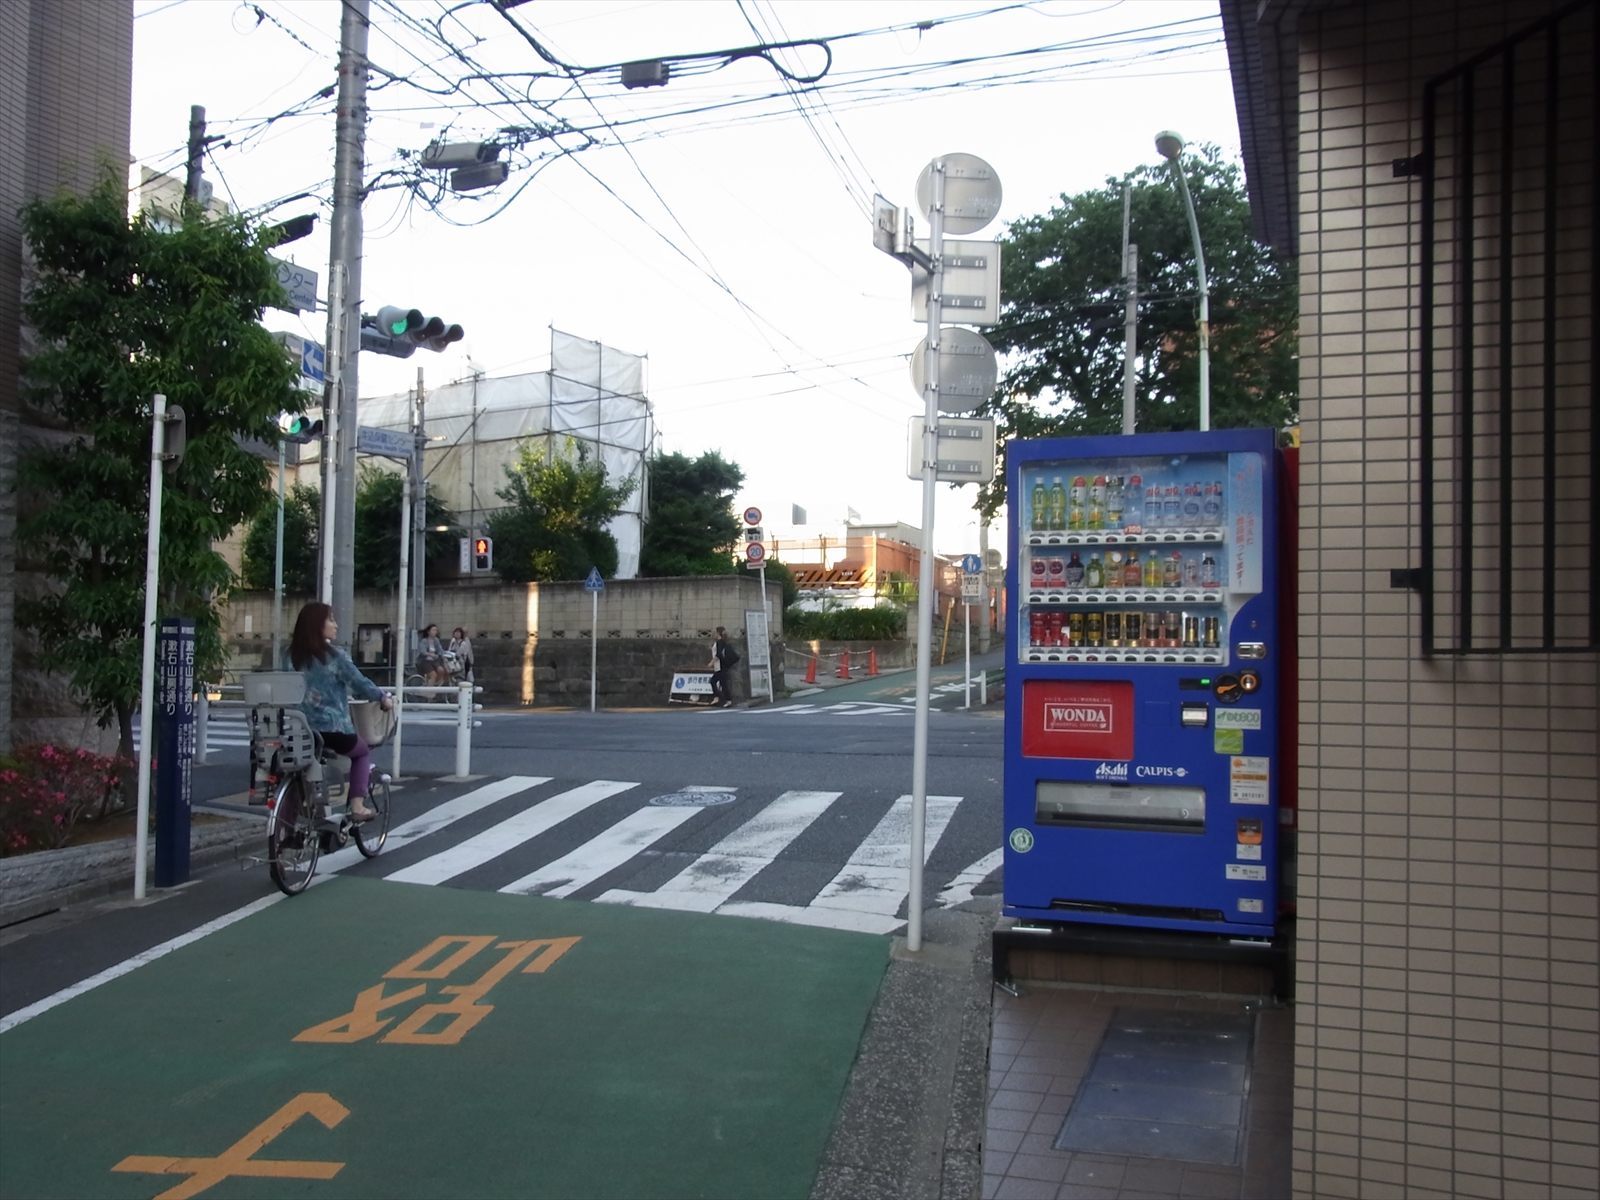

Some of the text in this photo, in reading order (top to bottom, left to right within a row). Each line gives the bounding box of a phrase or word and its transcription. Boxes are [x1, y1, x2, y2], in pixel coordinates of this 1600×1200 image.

[277, 263, 314, 289] ンター
[289, 289, 314, 305] Center
[750, 547, 762, 557] 20
[167, 640, 178, 716] 漱石山房通り
[184, 640, 195, 716] 漱石山房通り
[1051, 708, 1106, 722] WONDA
[1095, 762, 1128, 776] Asahi
[1135, 765, 1173, 777] CALPIS
